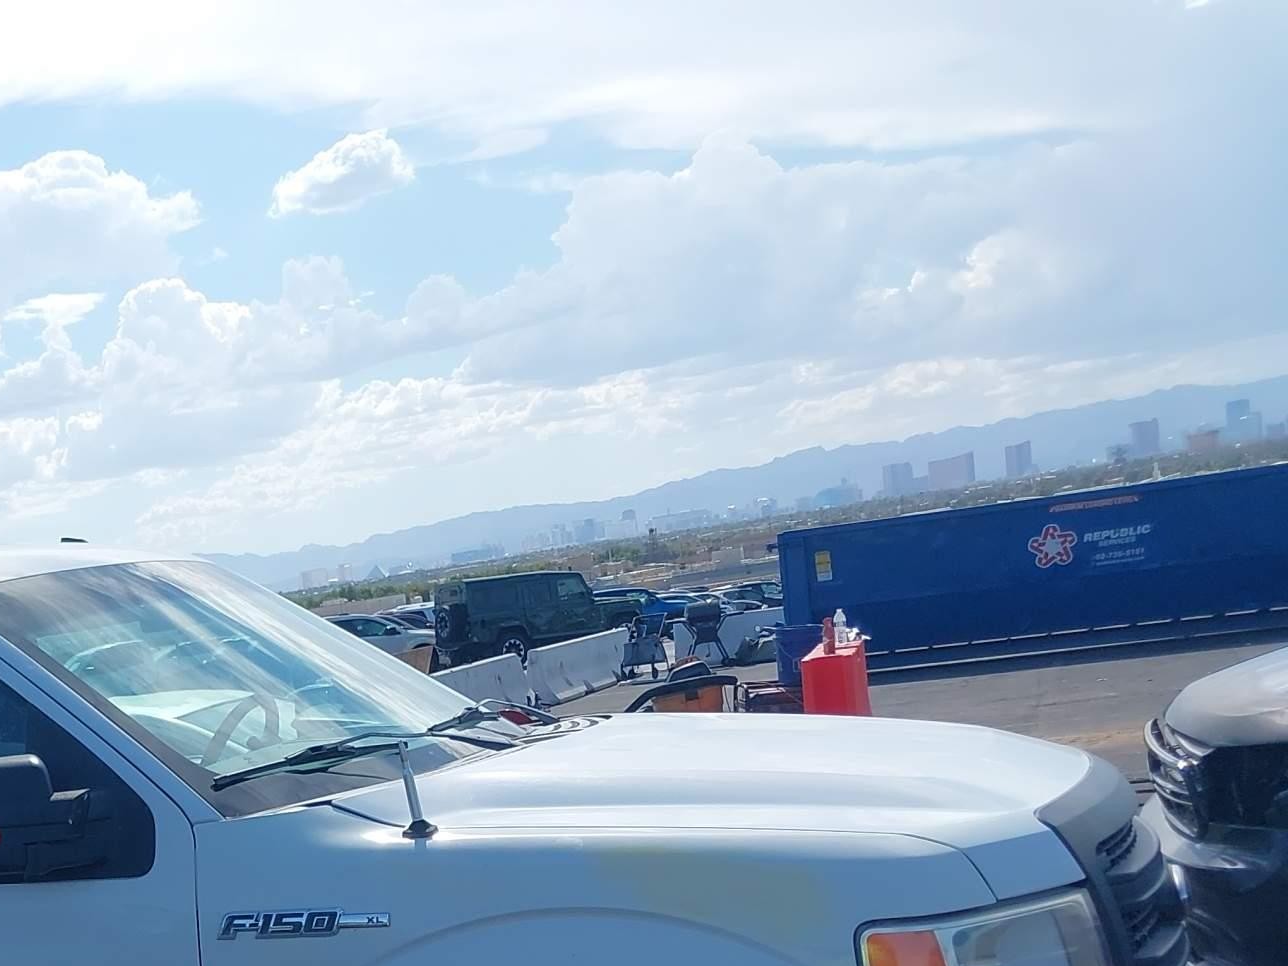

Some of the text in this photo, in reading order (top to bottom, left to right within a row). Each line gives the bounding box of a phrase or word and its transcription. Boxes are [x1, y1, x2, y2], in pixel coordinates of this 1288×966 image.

[1083, 524, 1152, 543] REPUBLIC
[216, 906, 385, 940] F-150 XL
